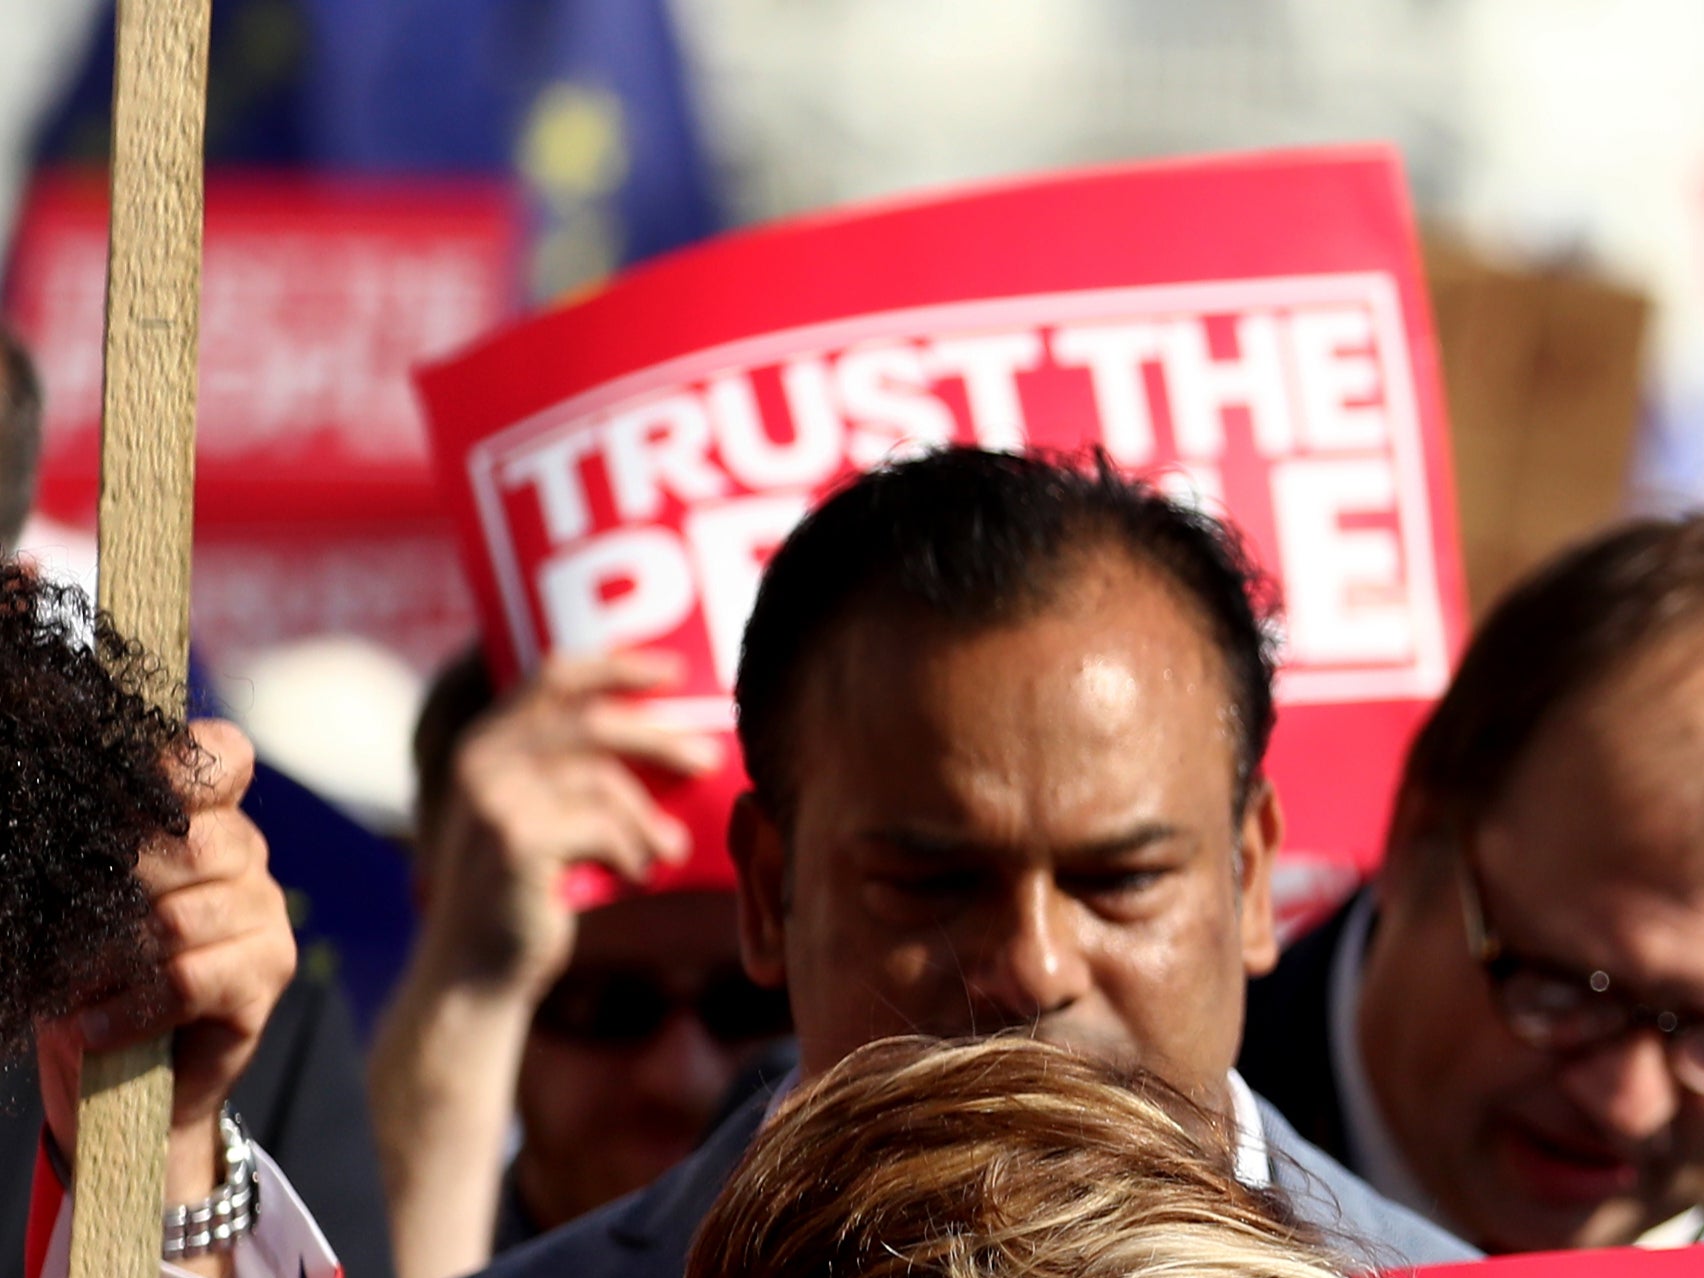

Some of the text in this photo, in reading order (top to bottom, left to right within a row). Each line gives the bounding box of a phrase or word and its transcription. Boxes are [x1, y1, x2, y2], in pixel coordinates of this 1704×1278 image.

[500, 330, 1043, 540] TRUST
[1054, 305, 1386, 464] THE
[535, 457, 1414, 690] PEE
